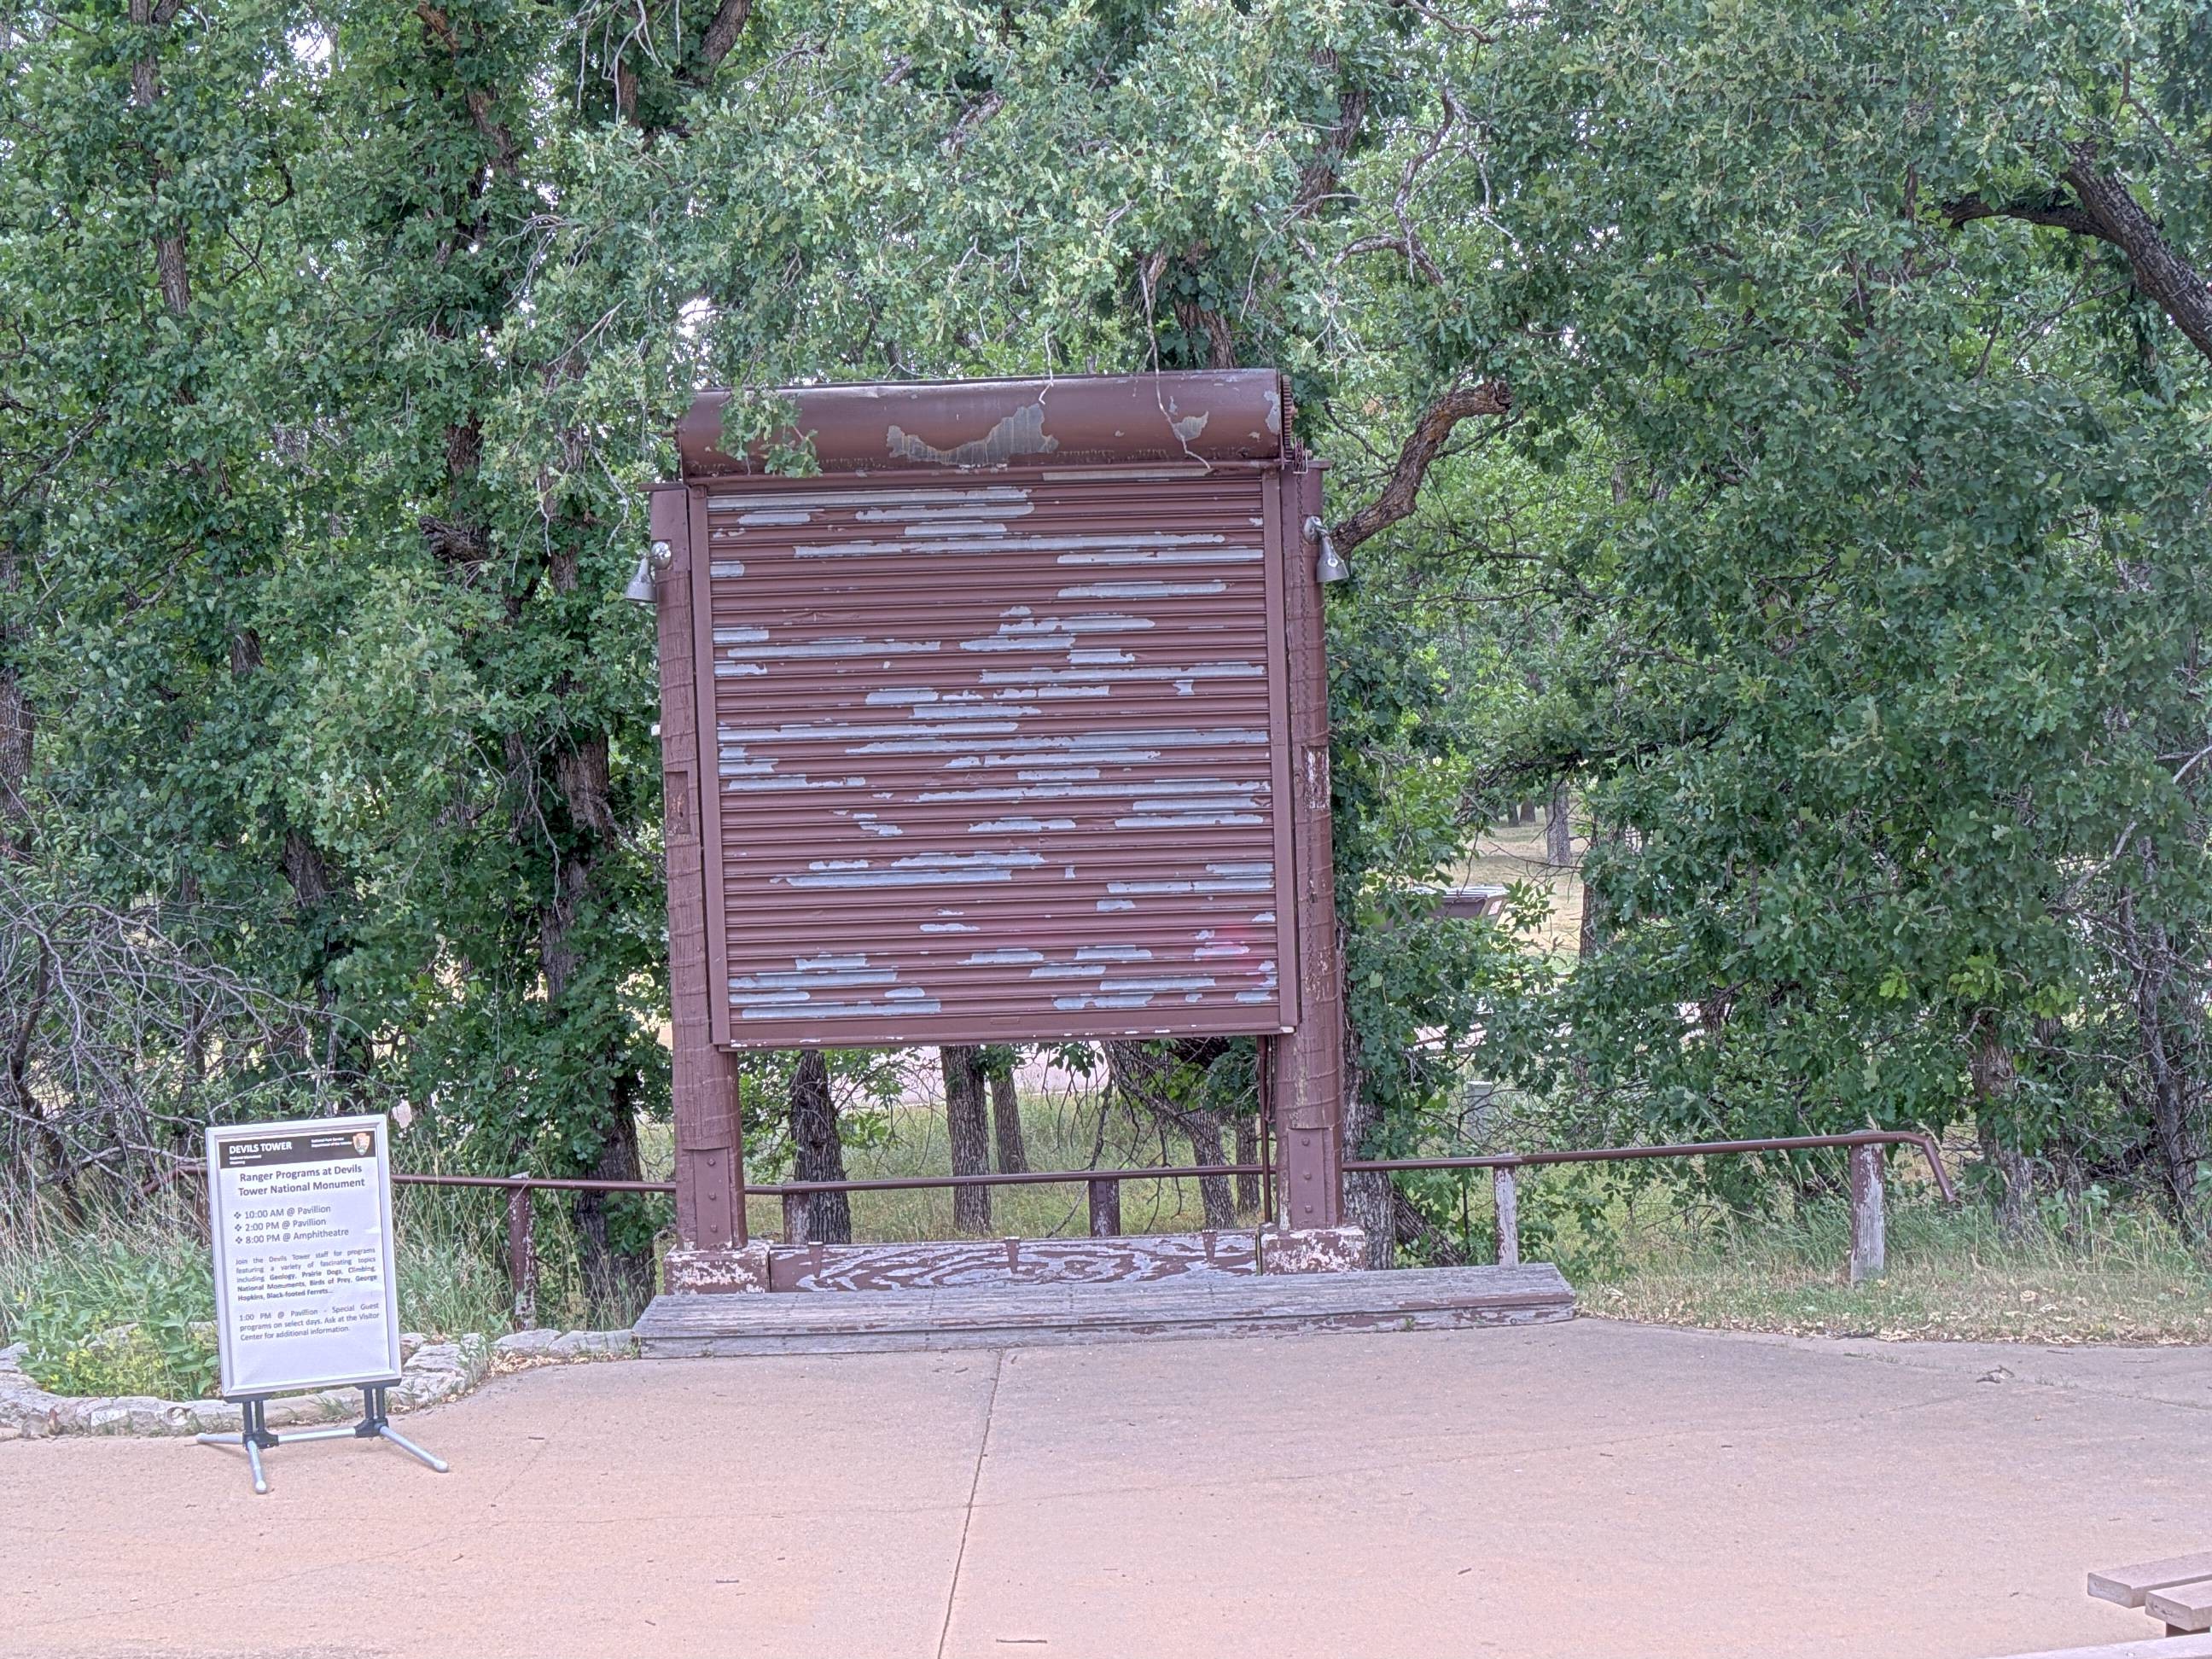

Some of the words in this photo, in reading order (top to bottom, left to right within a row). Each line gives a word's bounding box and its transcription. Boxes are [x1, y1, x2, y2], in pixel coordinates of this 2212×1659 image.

[230, 1144, 259, 1154] DEVILS
[260, 1142, 292, 1151] TOWER
[240, 1173, 273, 1182] Ranger
[276, 1169, 320, 1179] Programs
[335, 1164, 362, 1174] Devils
[238, 1187, 267, 1196] Tower
[271, 1182, 310, 1193] National
[313, 1179, 365, 1190] Monument
[246, 1210, 268, 1219] 10:00
[270, 1208, 284, 1217] AM
[287, 1208, 294, 1217] @
[298, 1205, 331, 1214] Pavillion
[245, 1223, 263, 1231] 2:00
[266, 1221, 280, 1230] PM
[282, 1220, 290, 1230] @
[293, 1218, 326, 1227] Pavillion
[246, 1235, 264, 1243] 8:00
[266, 1233, 280, 1242] PM
[282, 1233, 290, 1242] @
[294, 1229, 349, 1241] Amphitheatre
[347, 1248, 375, 1256] programs
[332, 1305, 354, 1313] Special
[276, 1328, 308, 1338] additional
